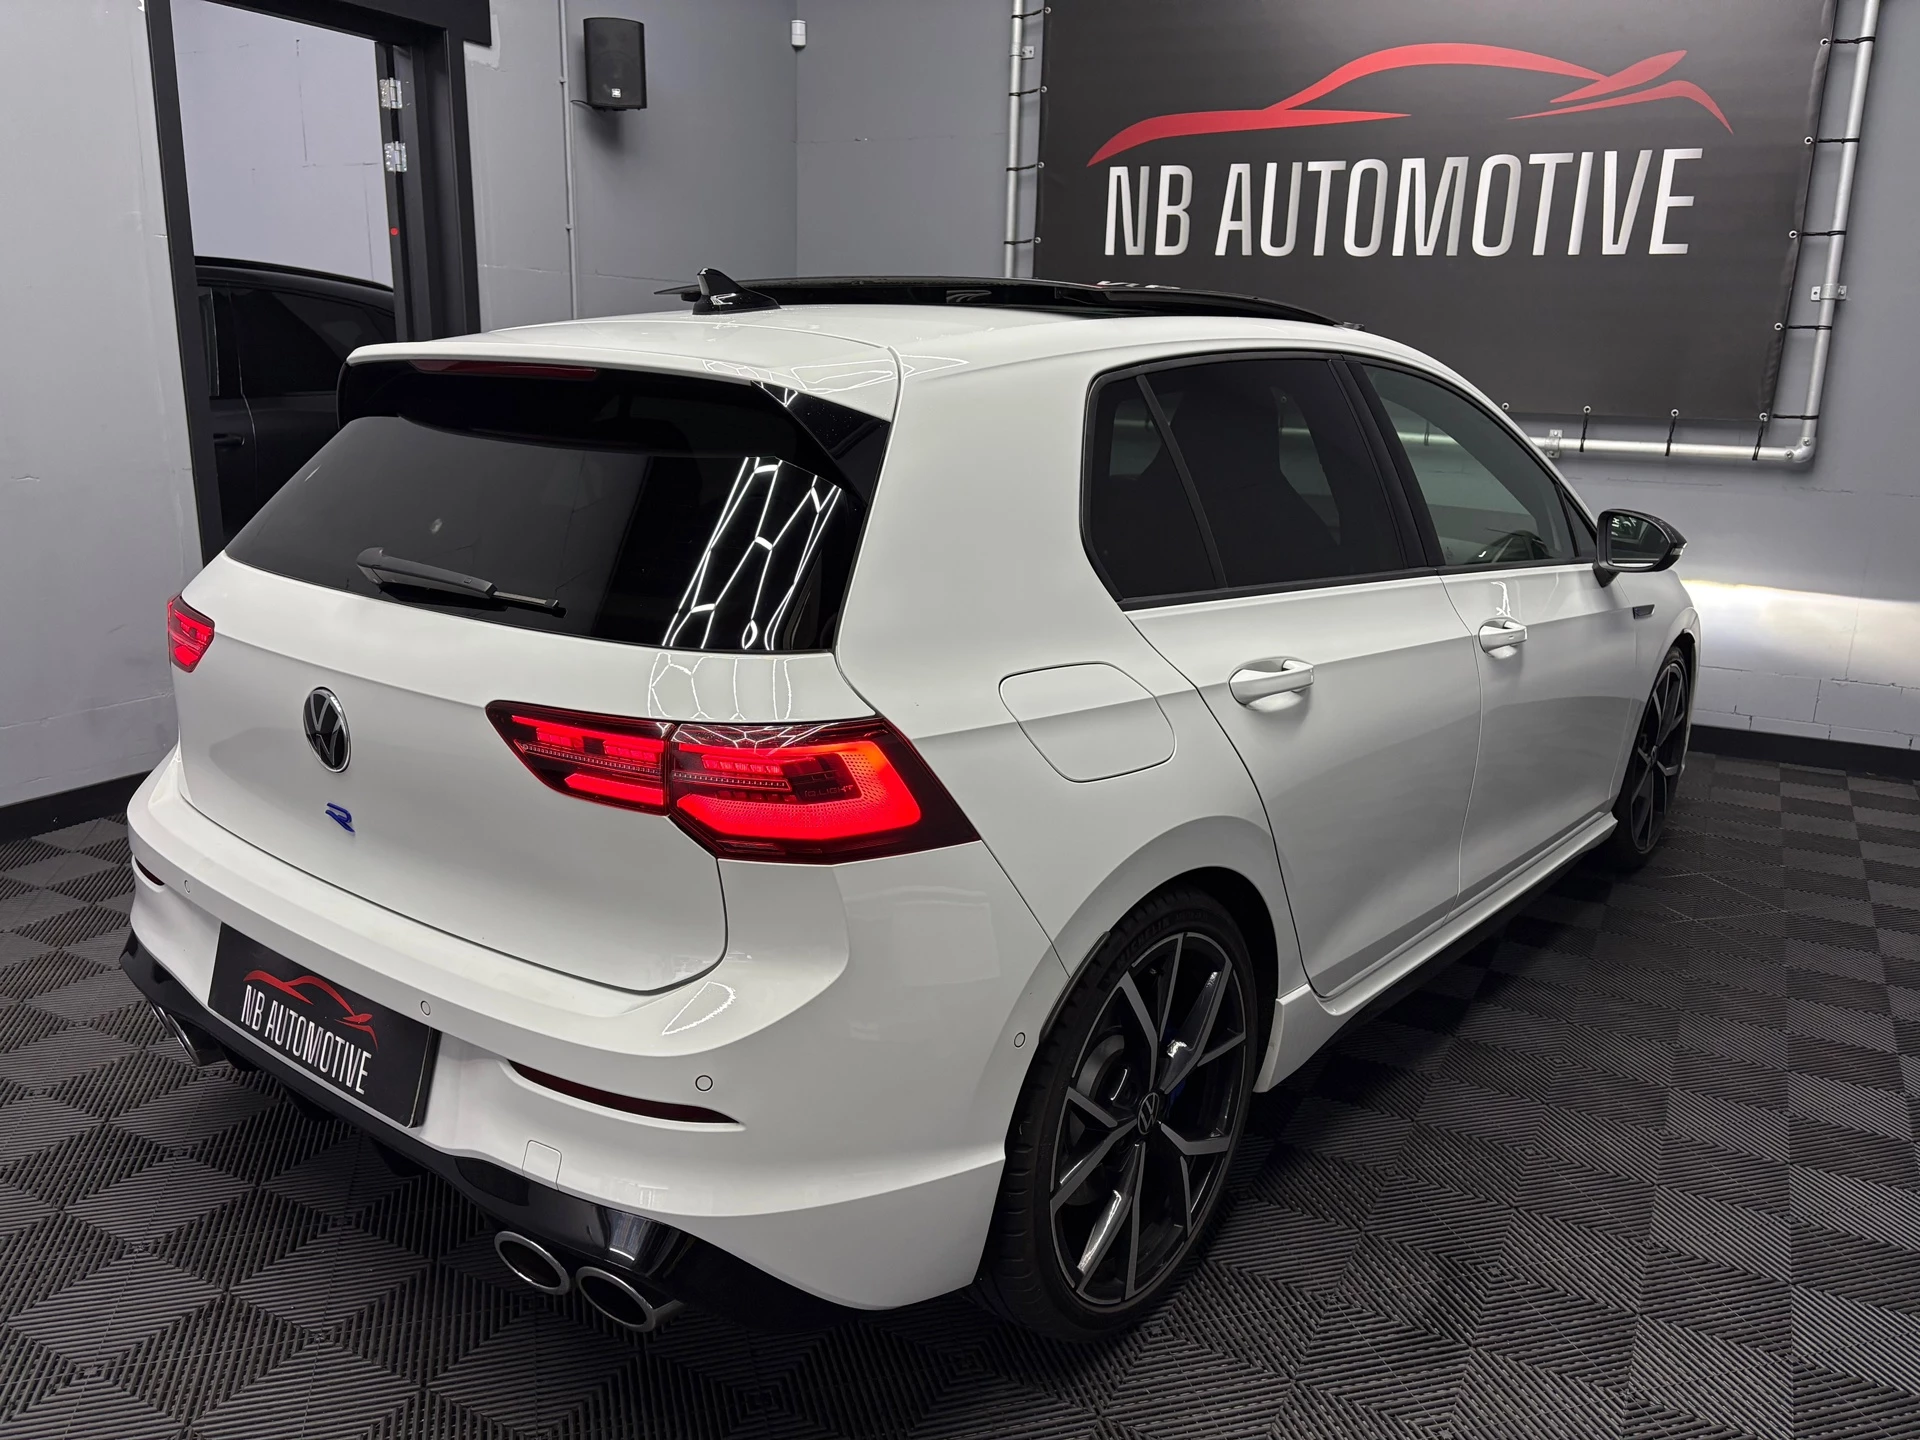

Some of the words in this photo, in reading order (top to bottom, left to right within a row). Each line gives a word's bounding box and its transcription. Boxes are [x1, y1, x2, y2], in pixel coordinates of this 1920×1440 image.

[1104, 165, 1194, 257] NB
[1214, 147, 1704, 257] AUTOMOTIVE
[325, 802, 356, 833] R
[240, 984, 266, 1032] NB
[264, 1000, 373, 1095] AUTOMOTIVE
